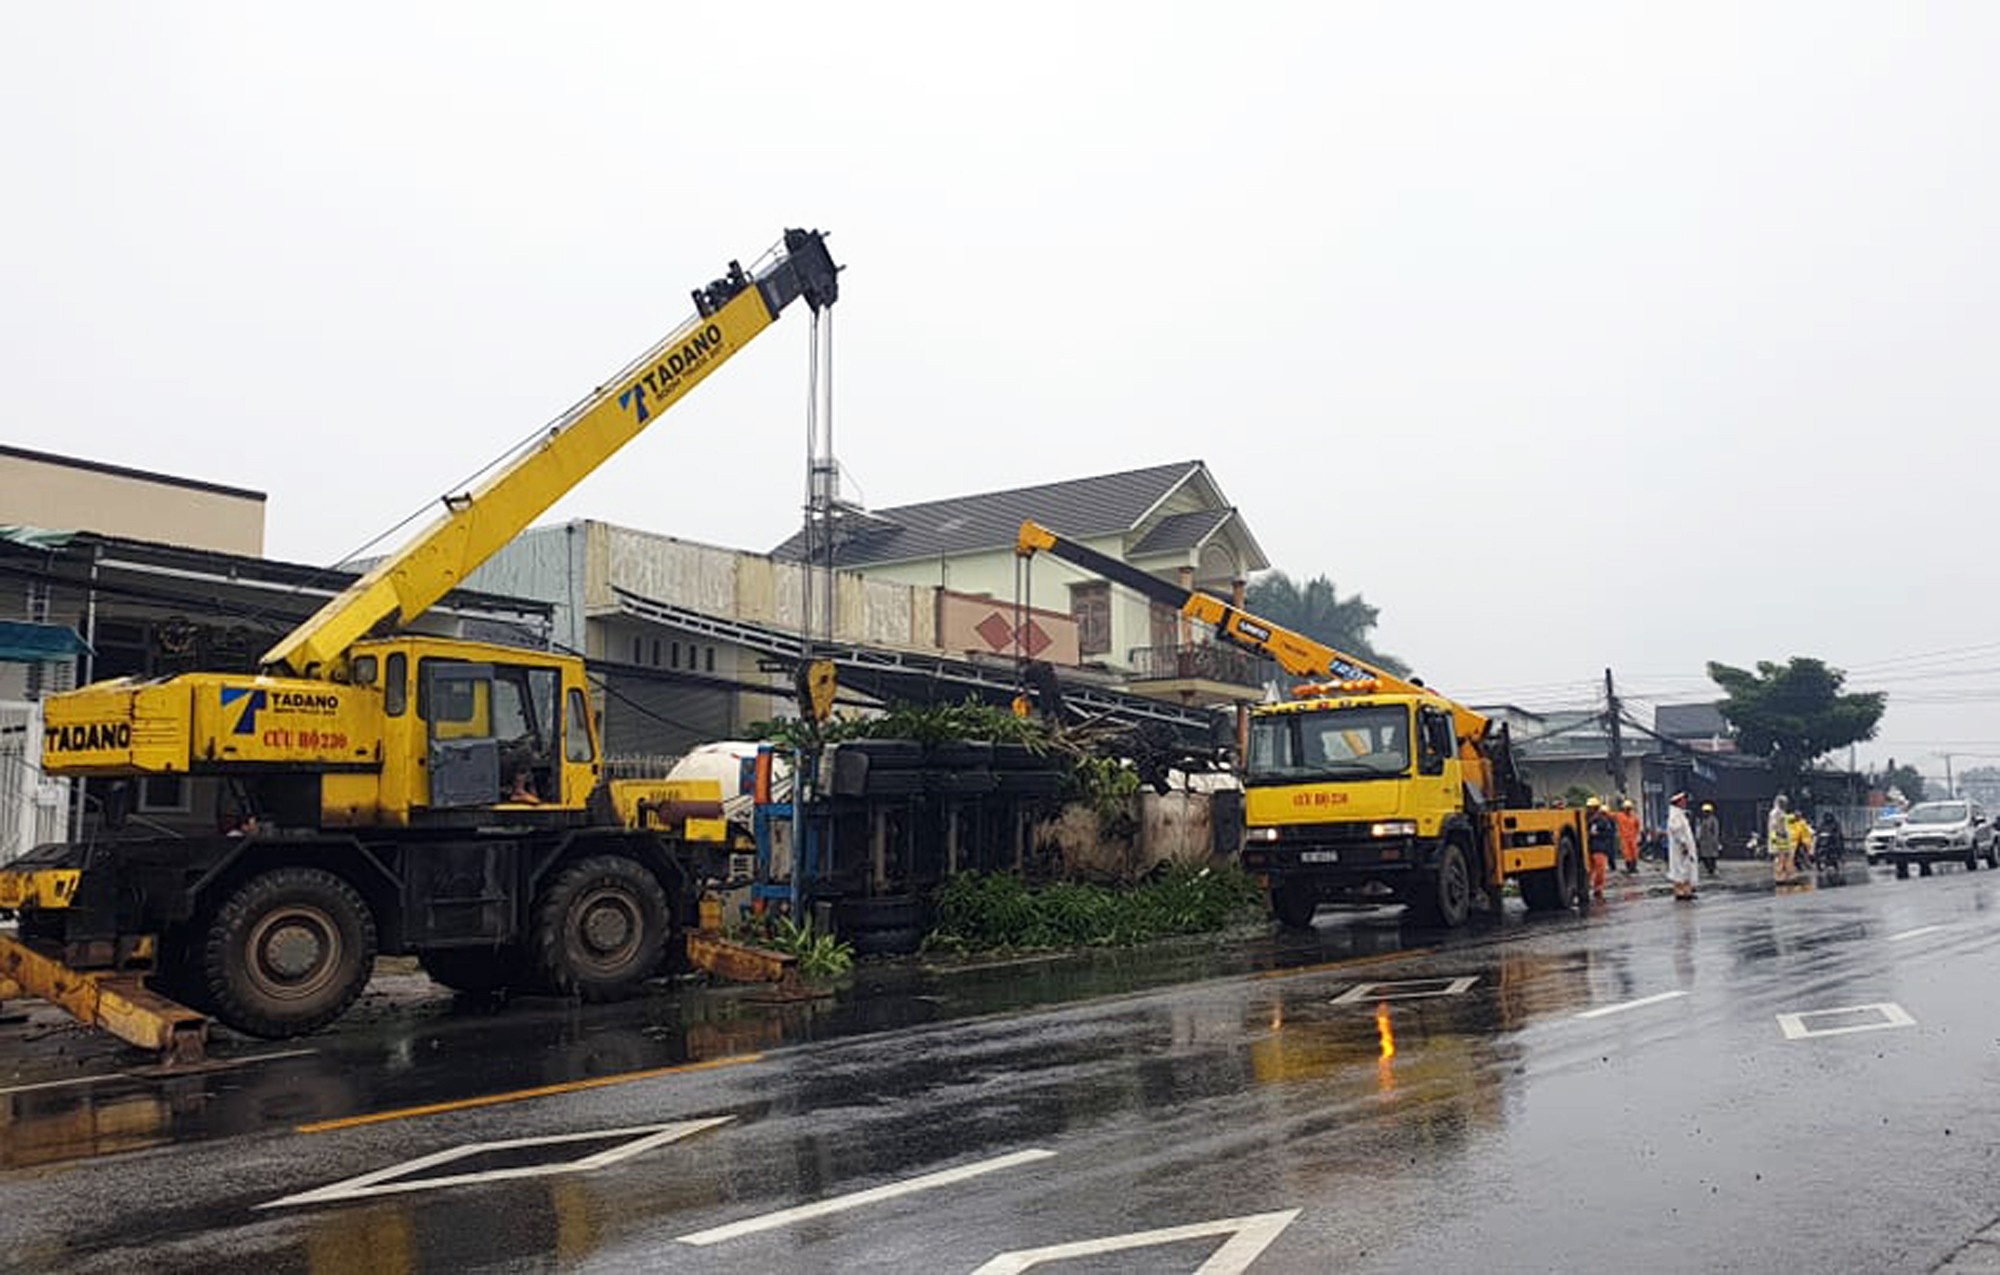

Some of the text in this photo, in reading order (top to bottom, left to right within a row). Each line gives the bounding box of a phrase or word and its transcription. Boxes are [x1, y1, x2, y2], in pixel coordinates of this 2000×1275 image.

[642, 323, 722, 393] TADANO
[271, 693, 338, 709] TADANO
[45, 723, 131, 752] TADANO
